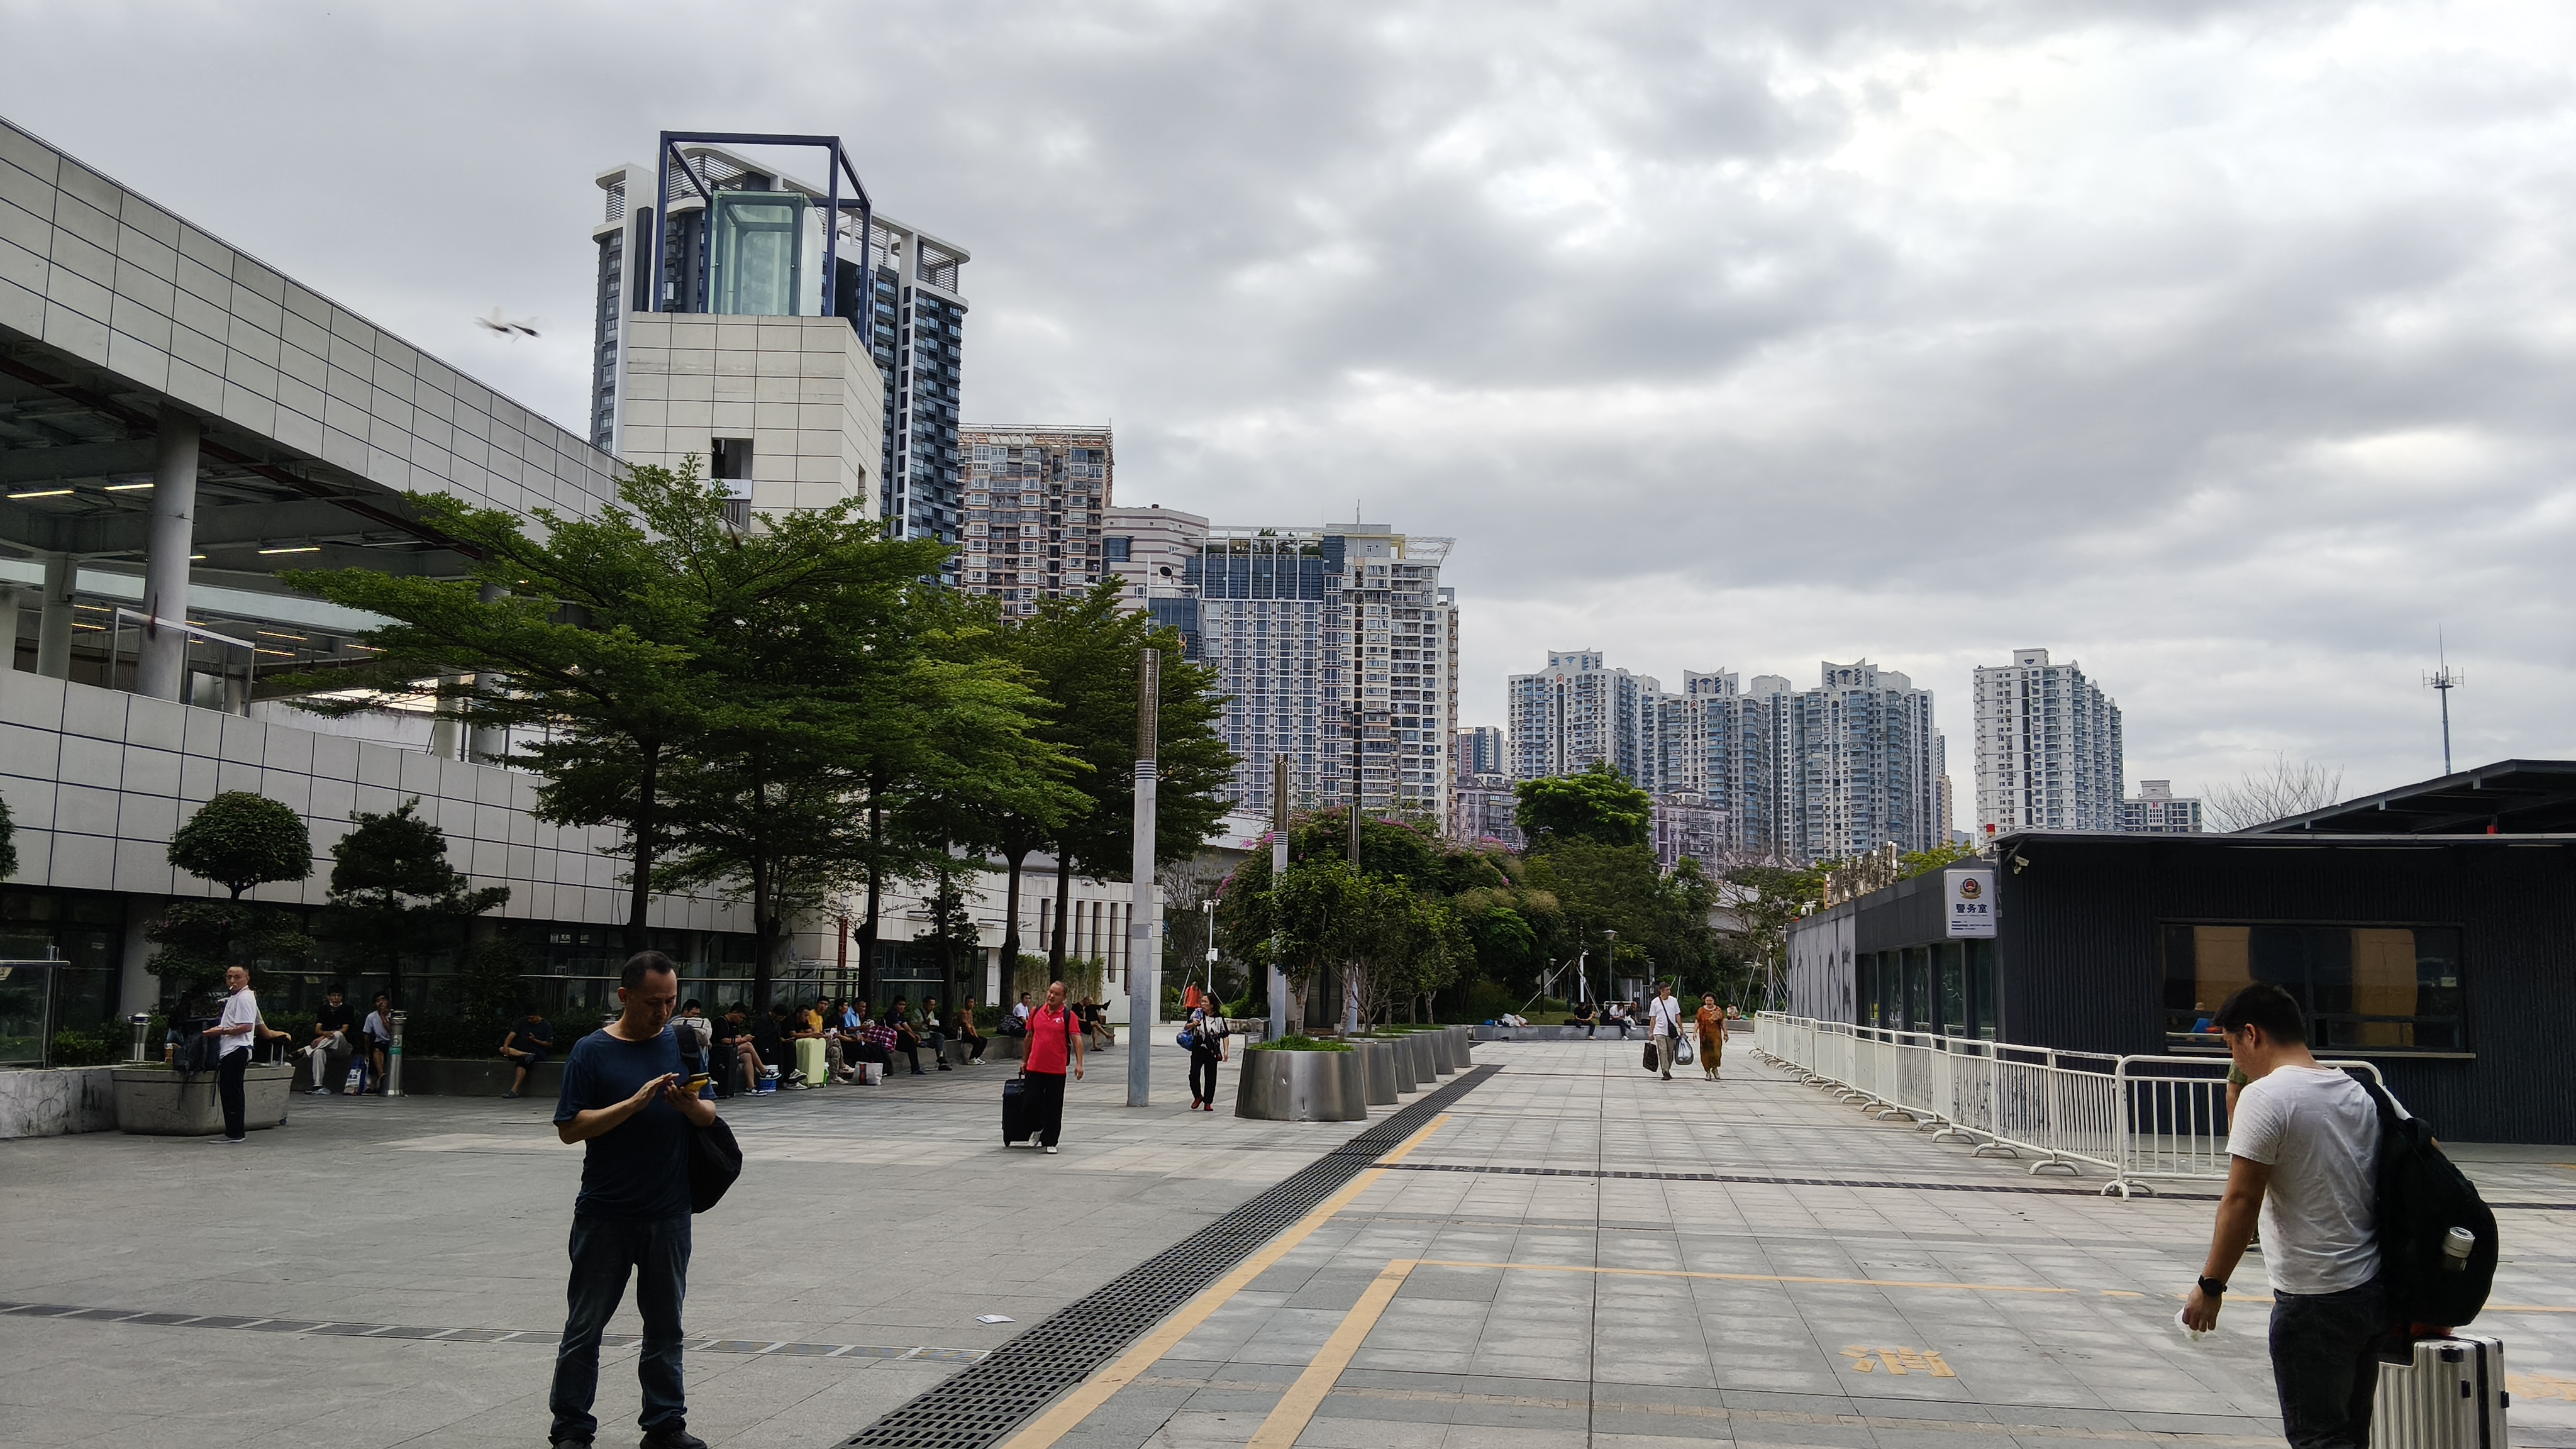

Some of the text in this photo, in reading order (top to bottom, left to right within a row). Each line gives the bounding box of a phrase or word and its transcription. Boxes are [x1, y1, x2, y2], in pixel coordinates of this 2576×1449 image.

[1955, 903, 1987, 913] 警务室
[1838, 1345, 1956, 1378] 消
